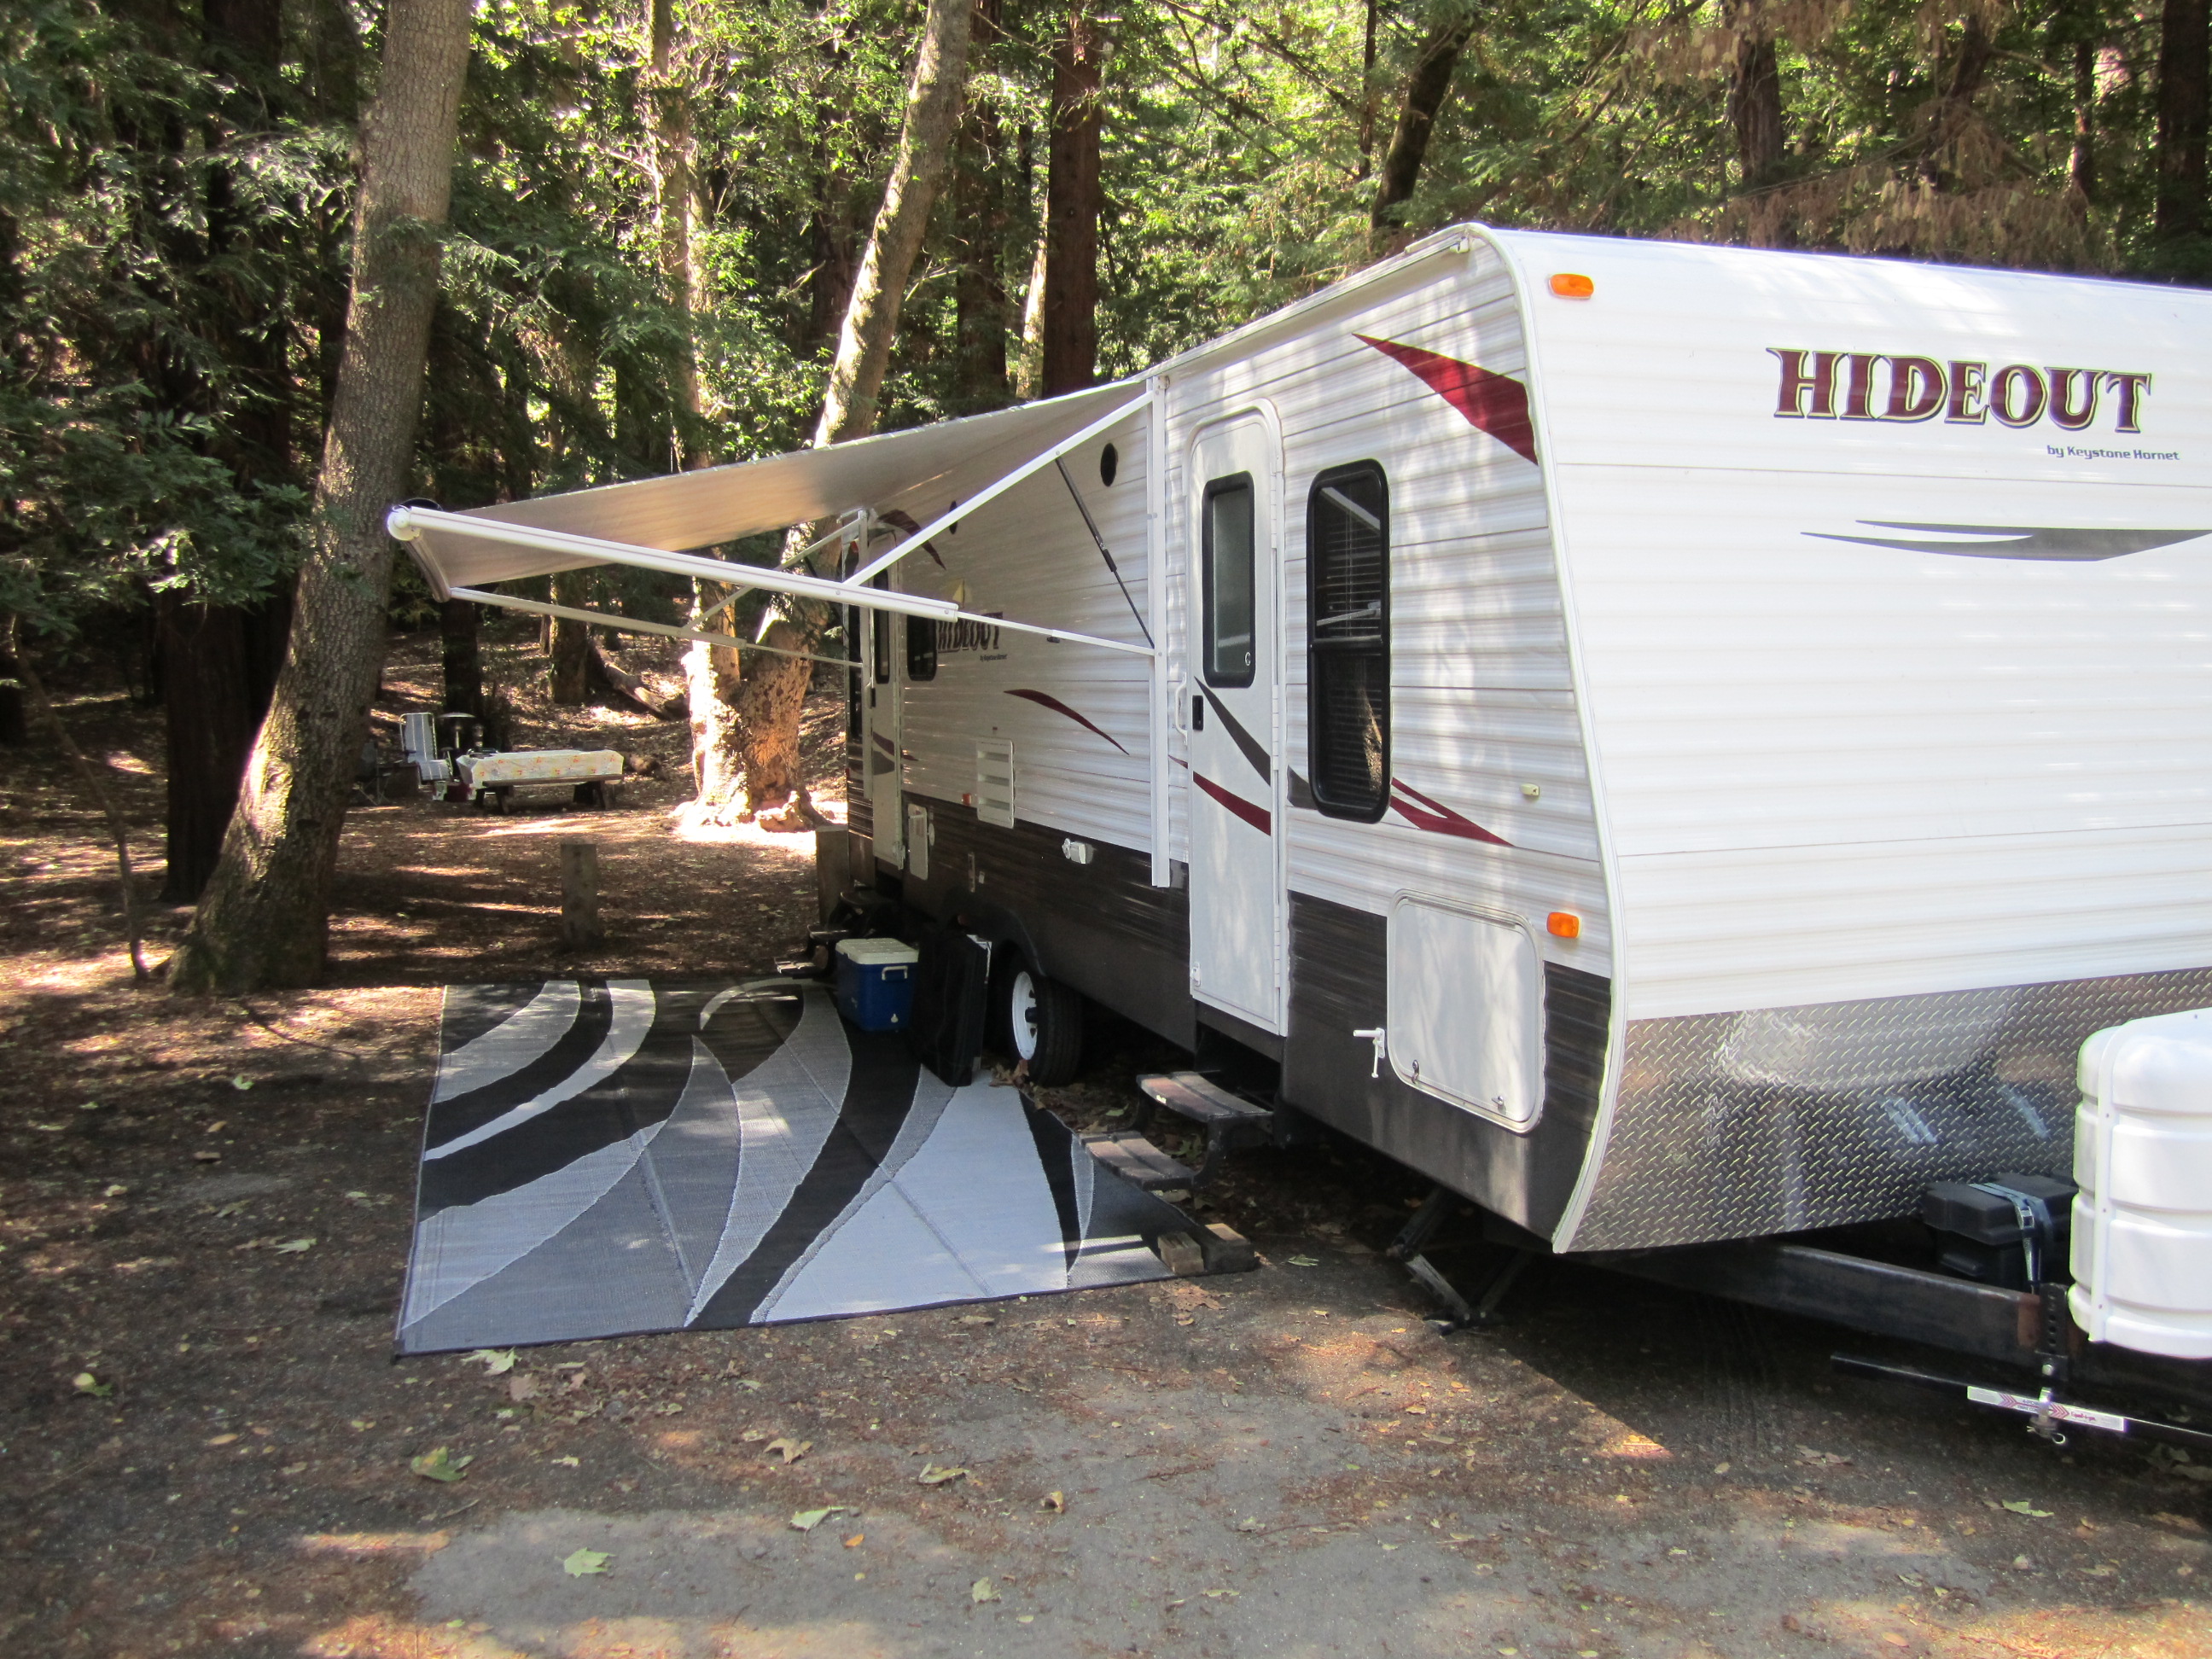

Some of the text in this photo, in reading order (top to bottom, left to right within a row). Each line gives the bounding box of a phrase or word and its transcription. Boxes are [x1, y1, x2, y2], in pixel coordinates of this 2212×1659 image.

[1766, 347, 2152, 434] HIDEOUT
[2046, 445, 2180, 460] by Keystone Hornet
